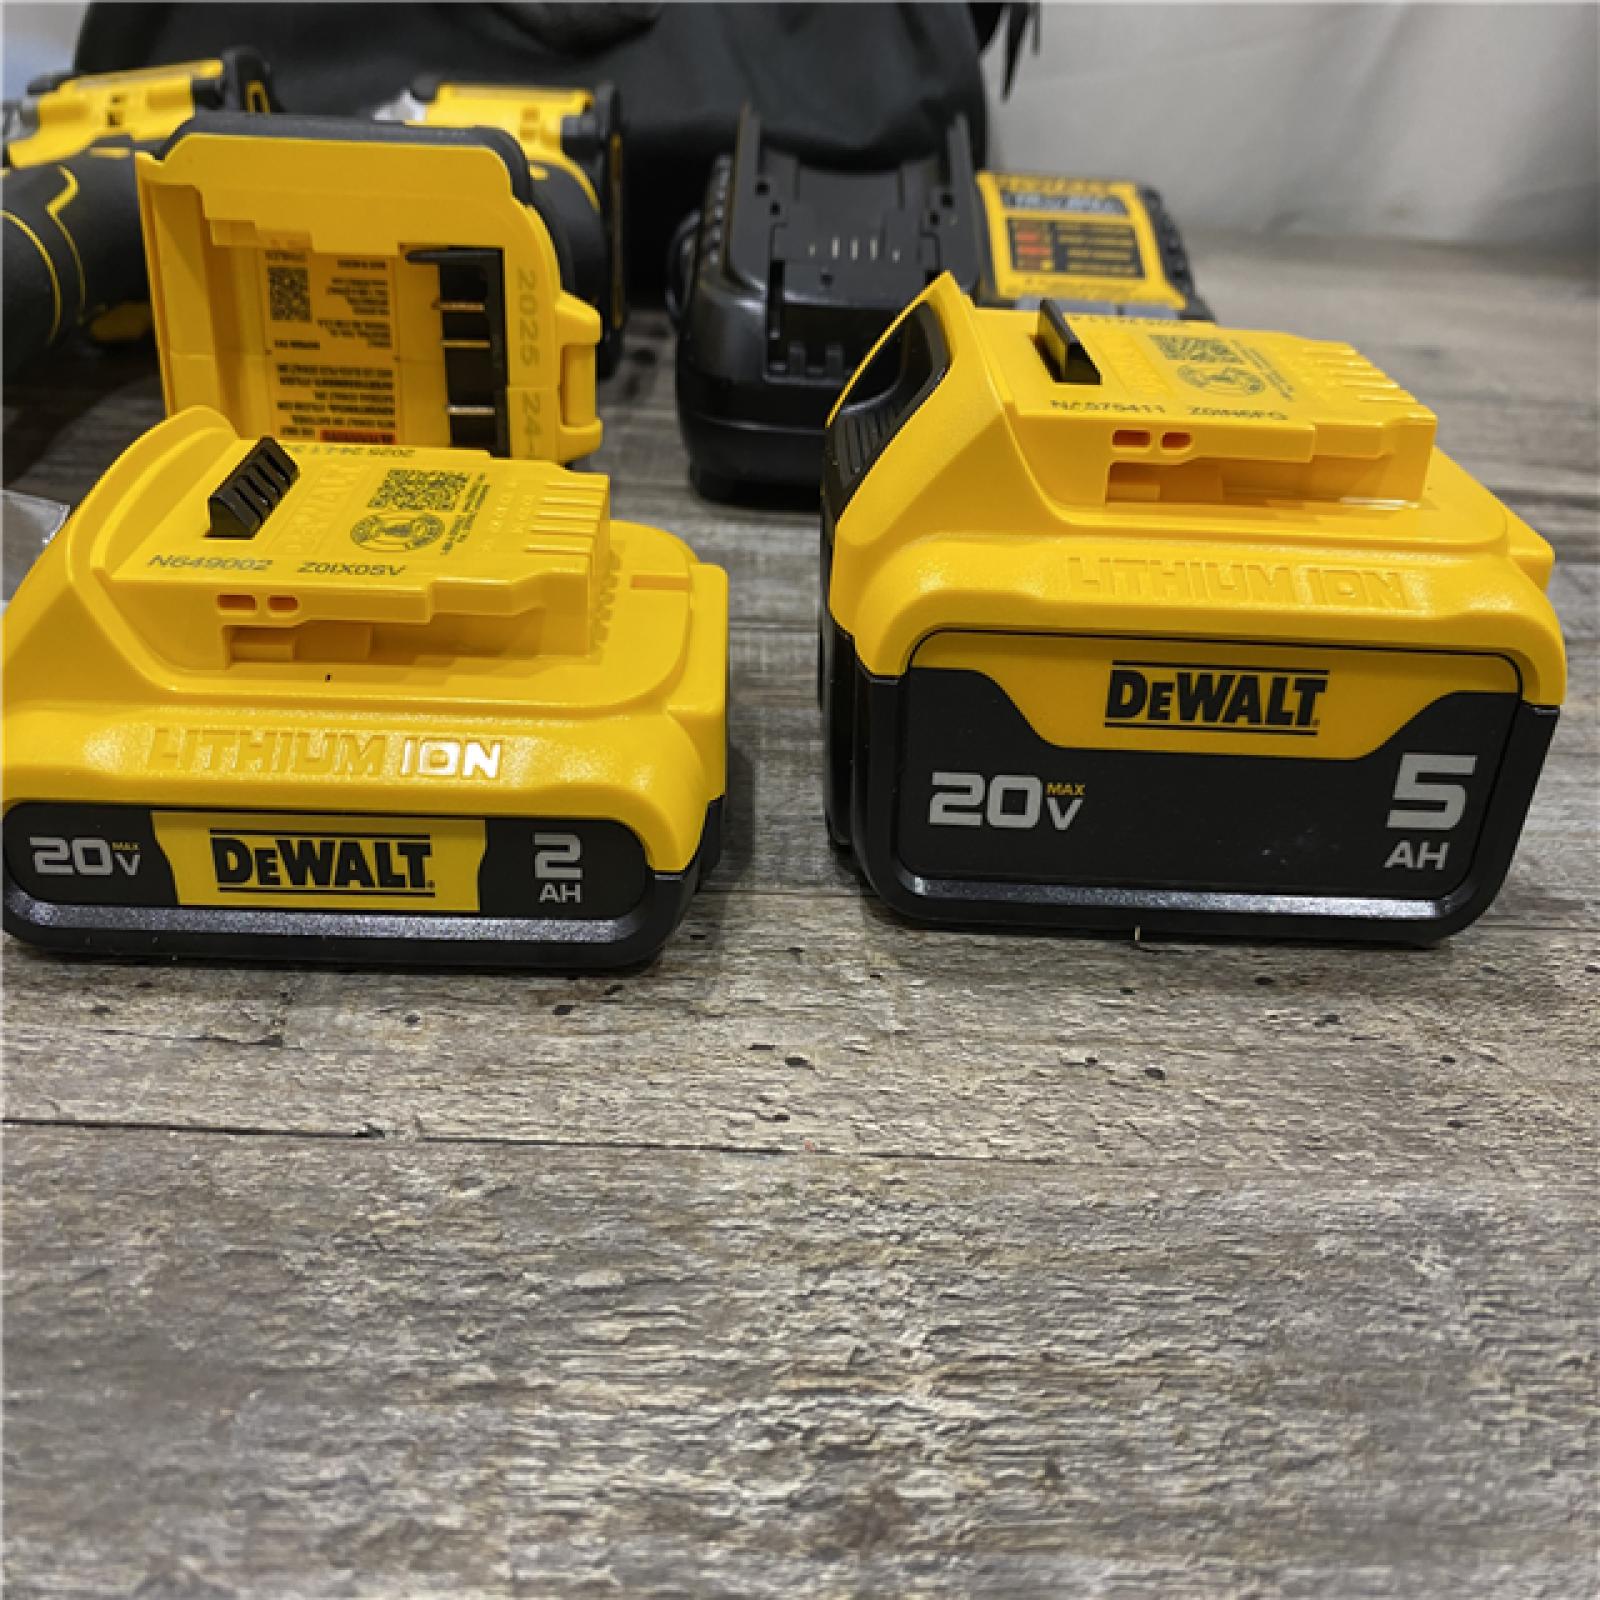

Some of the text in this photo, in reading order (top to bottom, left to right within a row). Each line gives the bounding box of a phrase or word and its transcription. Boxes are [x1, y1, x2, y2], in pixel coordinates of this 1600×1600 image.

[518, 268, 541, 366] 2025
[1067, 557, 1409, 610] LITHIUM ION
[149, 727, 504, 780] LITHIUM ION
[1045, 782, 1087, 797] MAX
[1386, 751, 1479, 831] 5
[111, 841, 140, 850] MAX
[533, 831, 584, 880] 2
[1383, 840, 1450, 871] AH
[538, 882, 582, 904] AH
